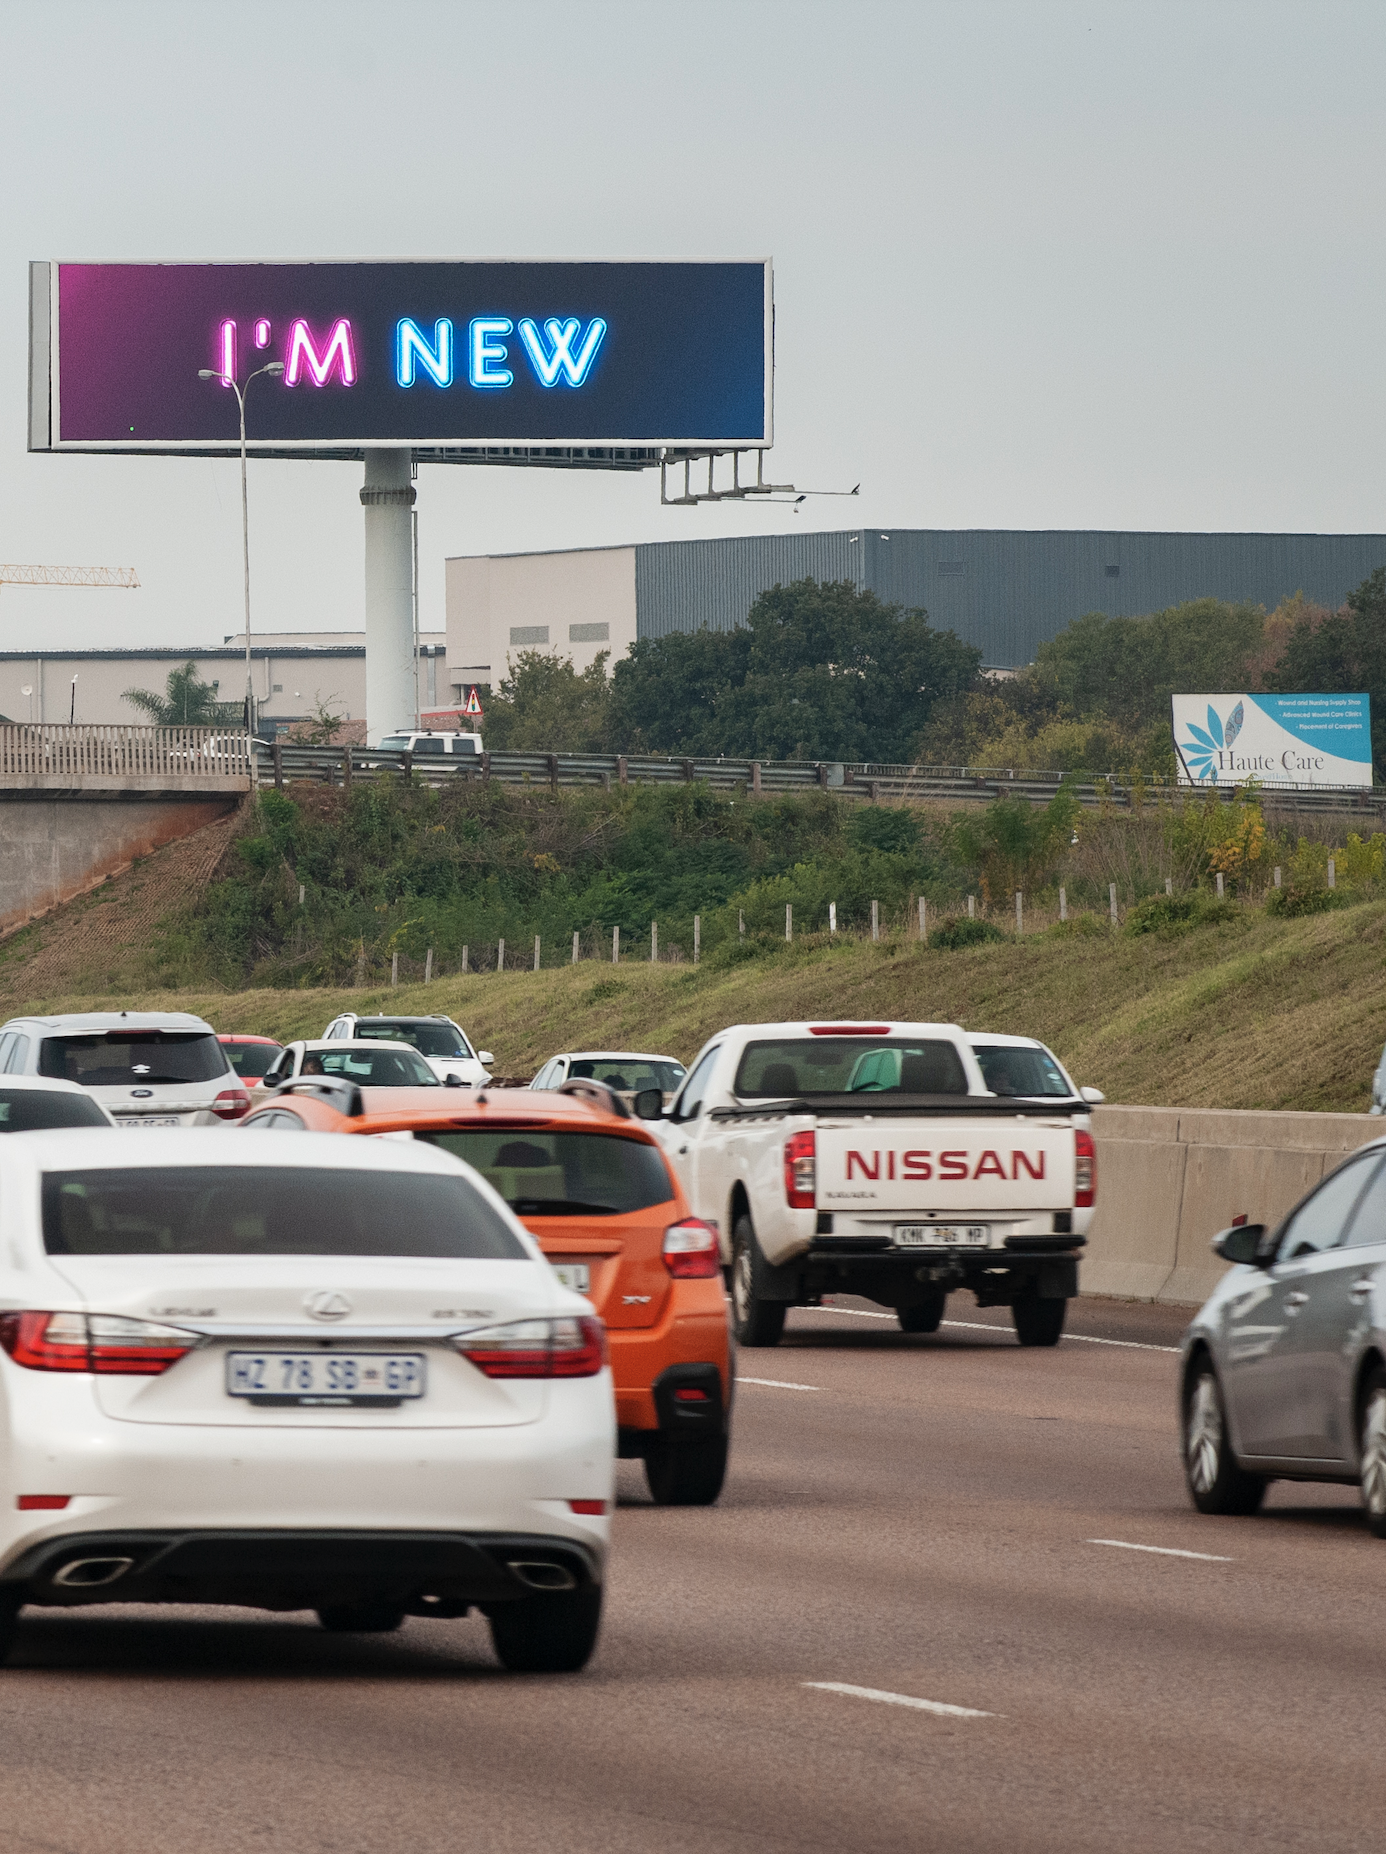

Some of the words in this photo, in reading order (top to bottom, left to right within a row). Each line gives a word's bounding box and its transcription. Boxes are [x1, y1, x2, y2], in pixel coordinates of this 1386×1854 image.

[220, 318, 357, 388] I'M
[397, 317, 607, 388] NEW
[1218, 750, 1275, 770] Haute
[1281, 750, 1324, 770] Care
[845, 1150, 1045, 1180] NISSAN
[233, 1359, 266, 1390] HZ
[281, 1359, 314, 1390] 78
[327, 1359, 360, 1390] SB
[385, 1360, 416, 1390] GP
